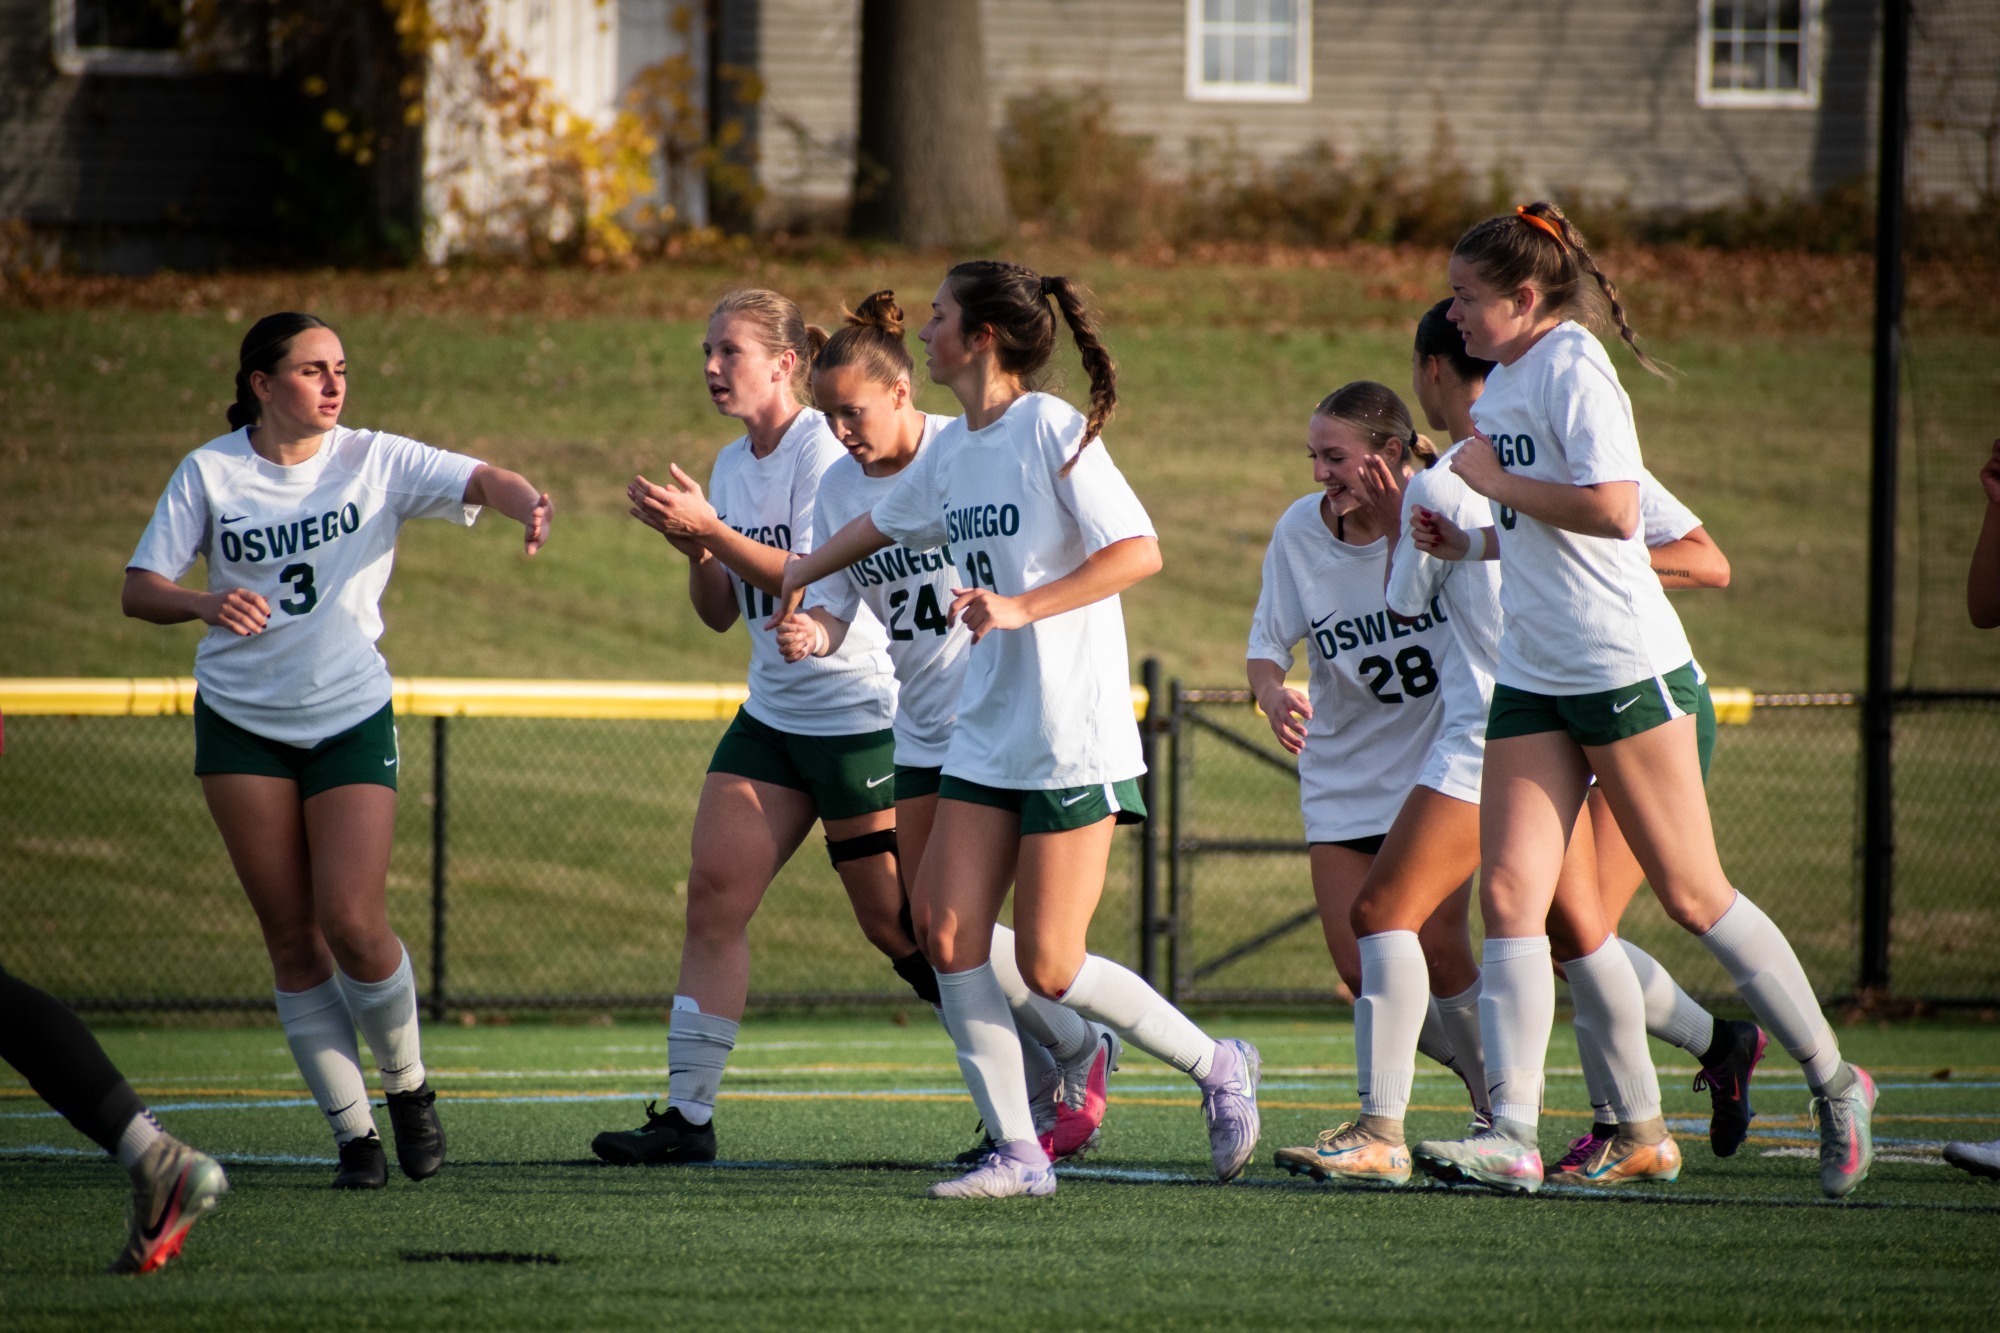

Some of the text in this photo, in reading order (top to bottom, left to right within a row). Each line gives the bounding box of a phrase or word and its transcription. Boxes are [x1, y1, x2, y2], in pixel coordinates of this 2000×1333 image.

[220, 502, 360, 563] OSWEGO
[279, 562, 317, 616] 3
[966, 550, 999, 594] 19
[889, 583, 948, 641] 24
[1358, 645, 1439, 704] 28
